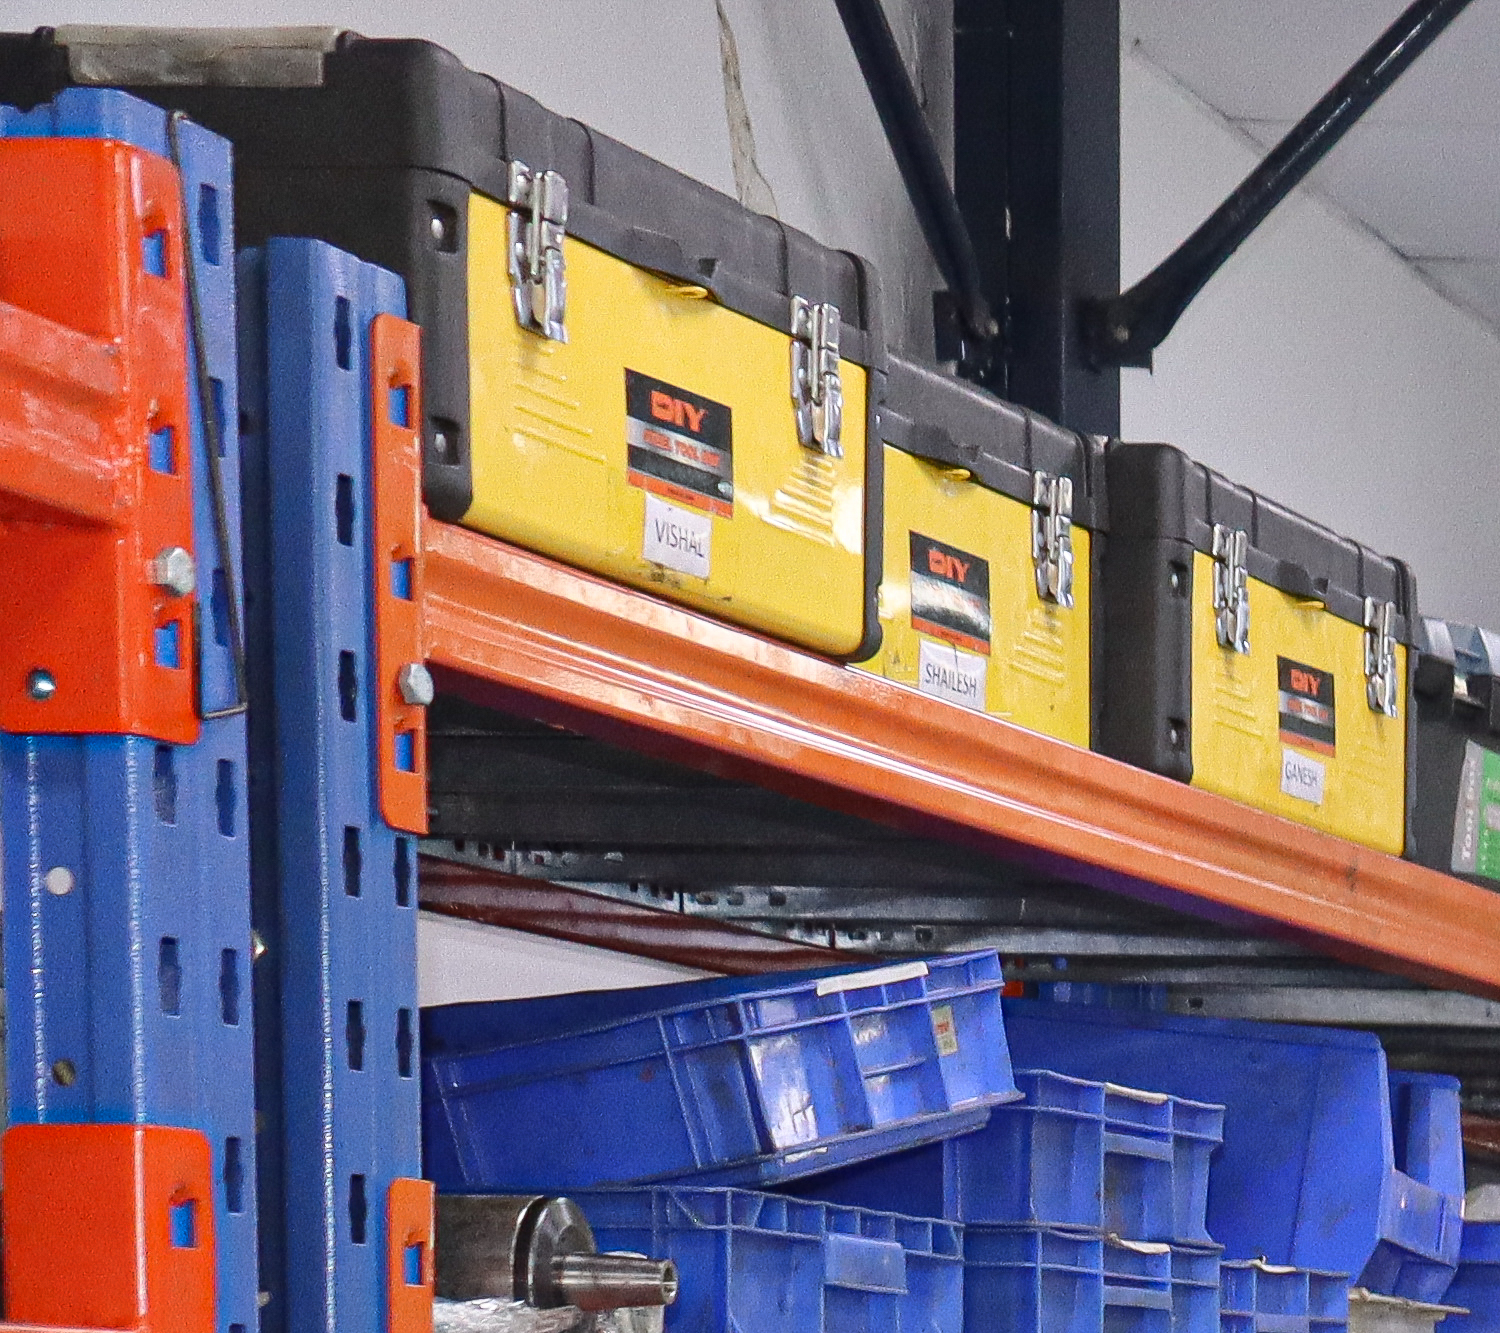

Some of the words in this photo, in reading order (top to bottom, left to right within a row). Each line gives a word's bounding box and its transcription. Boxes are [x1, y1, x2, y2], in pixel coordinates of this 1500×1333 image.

[650, 390, 708, 433] DIY
[655, 517, 705, 558] VISHAL
[928, 549, 971, 583] DIY
[925, 663, 977, 698] SHAILESH
[1290, 668, 1321, 697] DIY
[1285, 761, 1318, 787] GANESH
